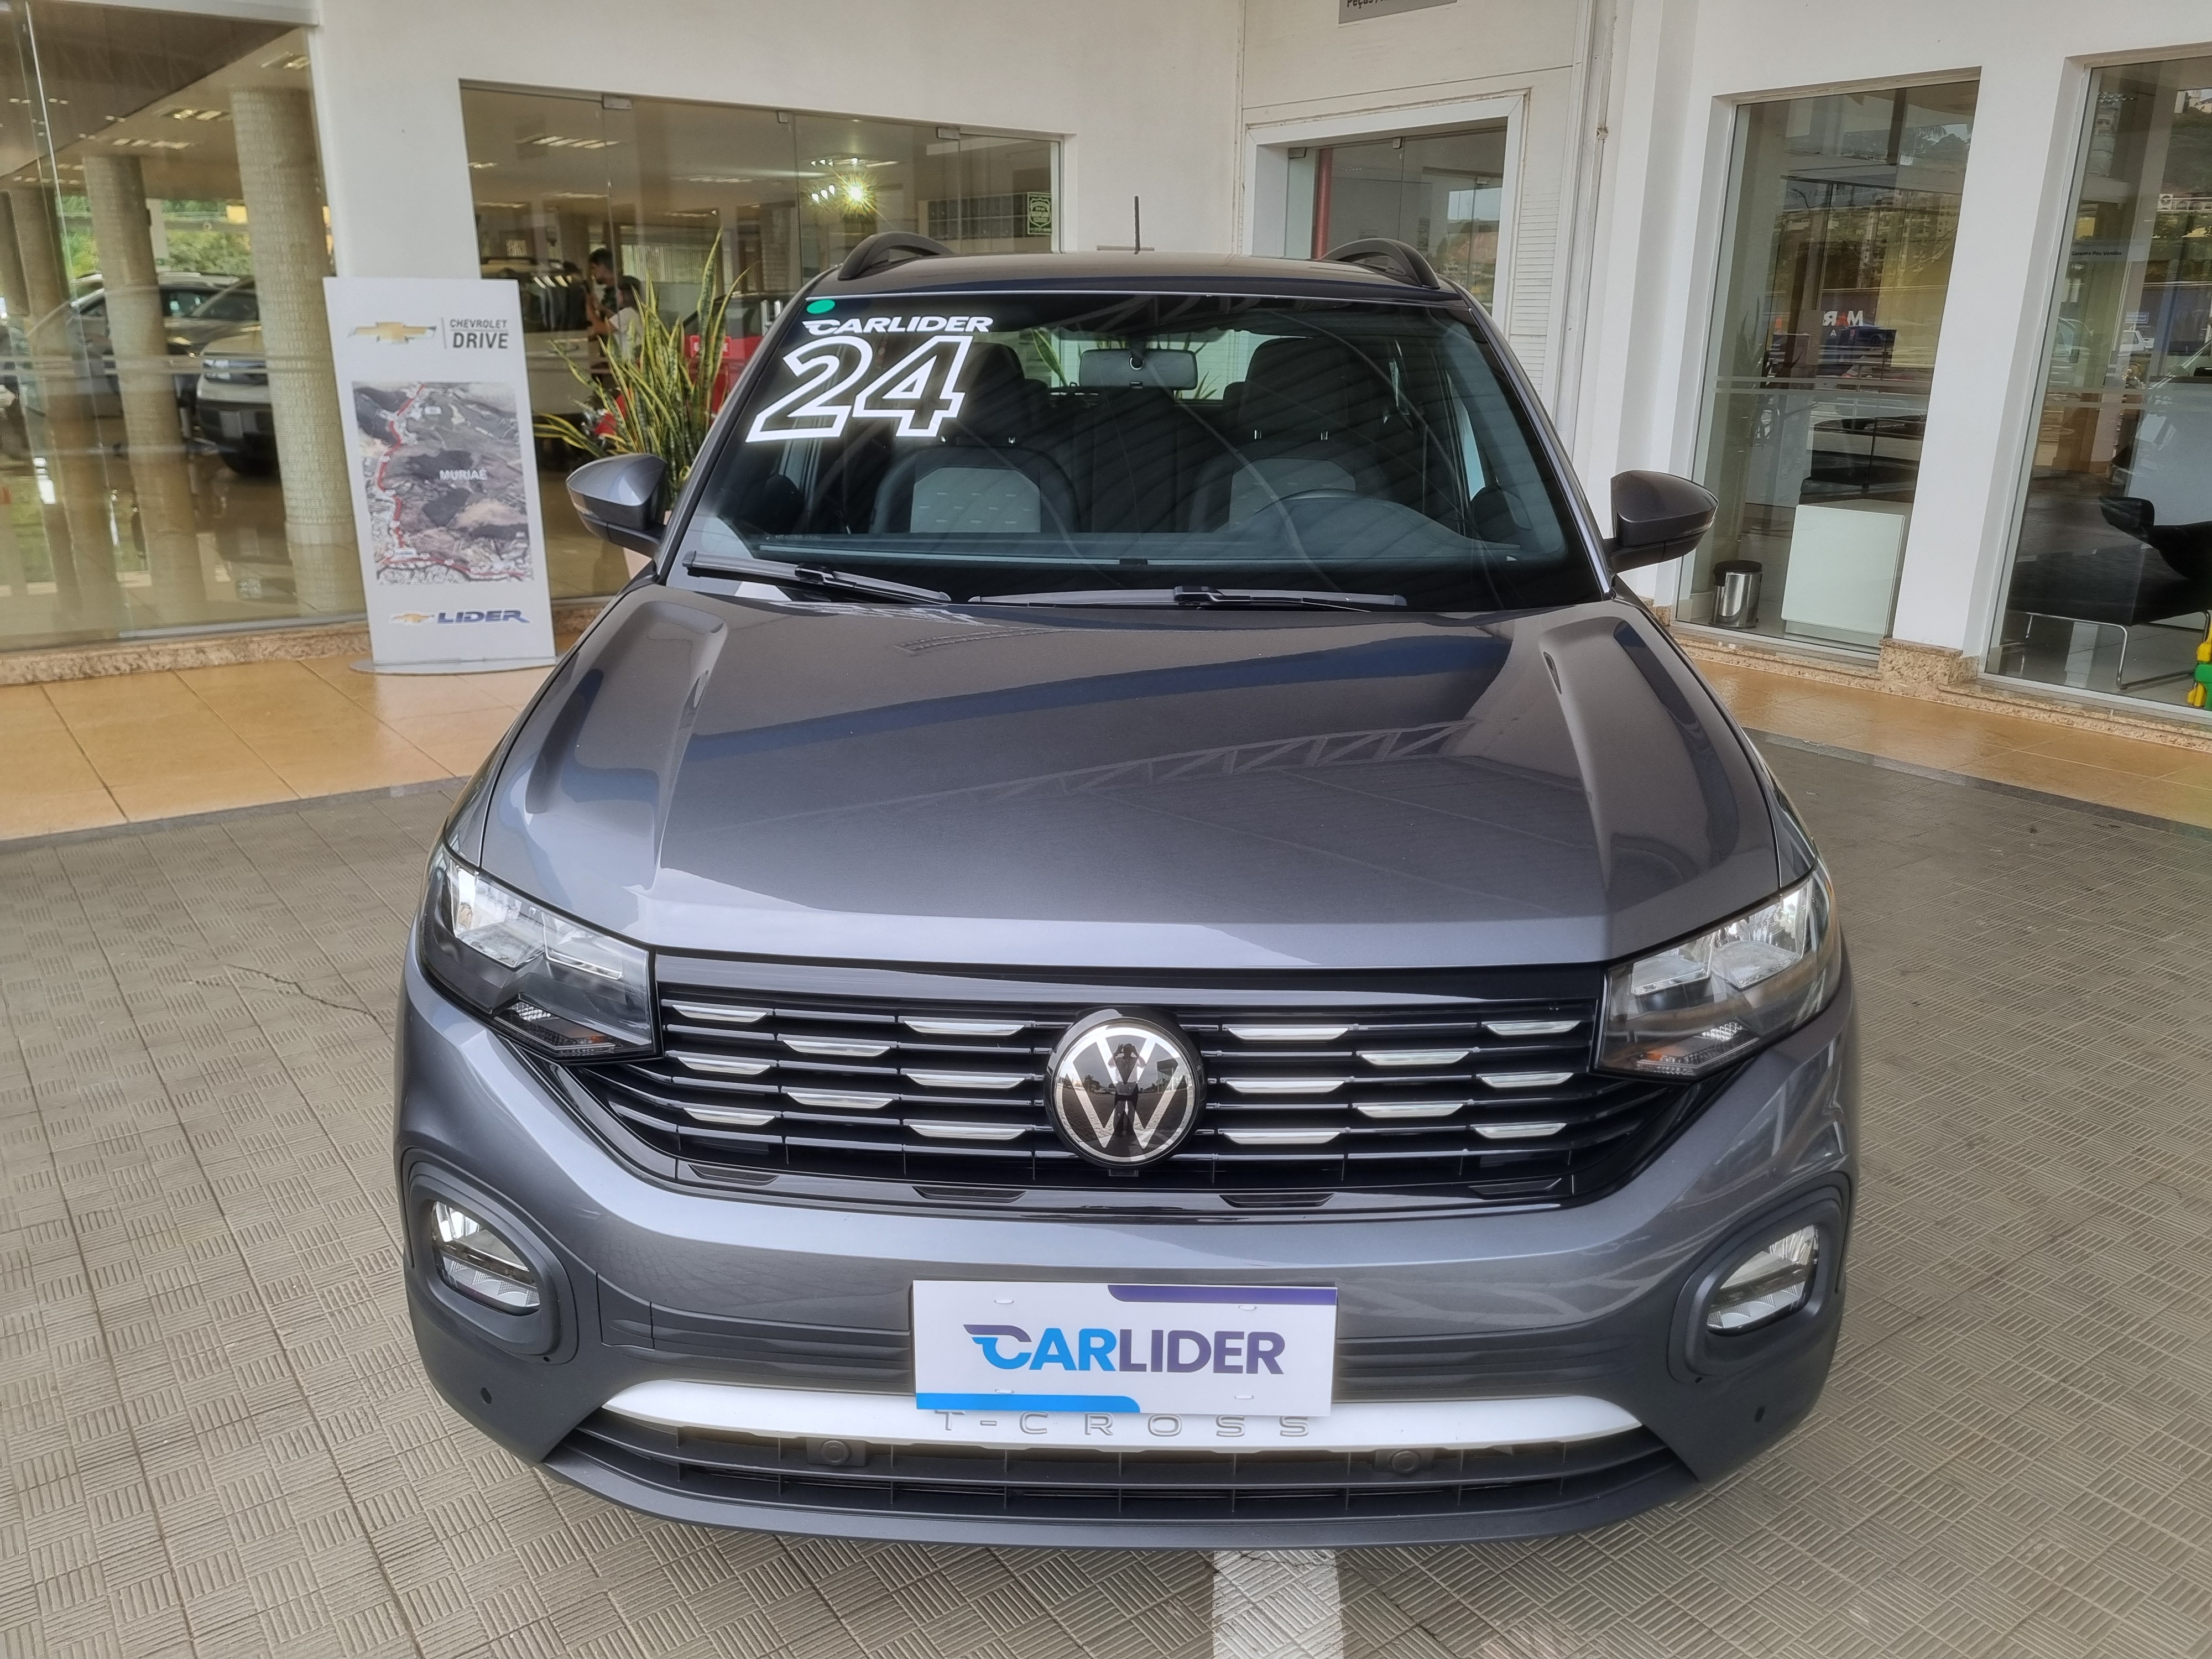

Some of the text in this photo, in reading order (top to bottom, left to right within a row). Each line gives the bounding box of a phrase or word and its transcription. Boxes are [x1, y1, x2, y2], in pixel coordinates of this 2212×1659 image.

[450, 319, 508, 328] CHEVROLET
[802, 316, 994, 335] CARLIDER
[453, 332, 509, 349] DRIVE
[745, 335, 973, 442] 24
[439, 467, 488, 481] MURIAÉ
[436, 609, 531, 624] LIDER
[963, 1324, 1286, 1375] CARLIDER
[935, 1410, 1310, 1437] T-CROSS
